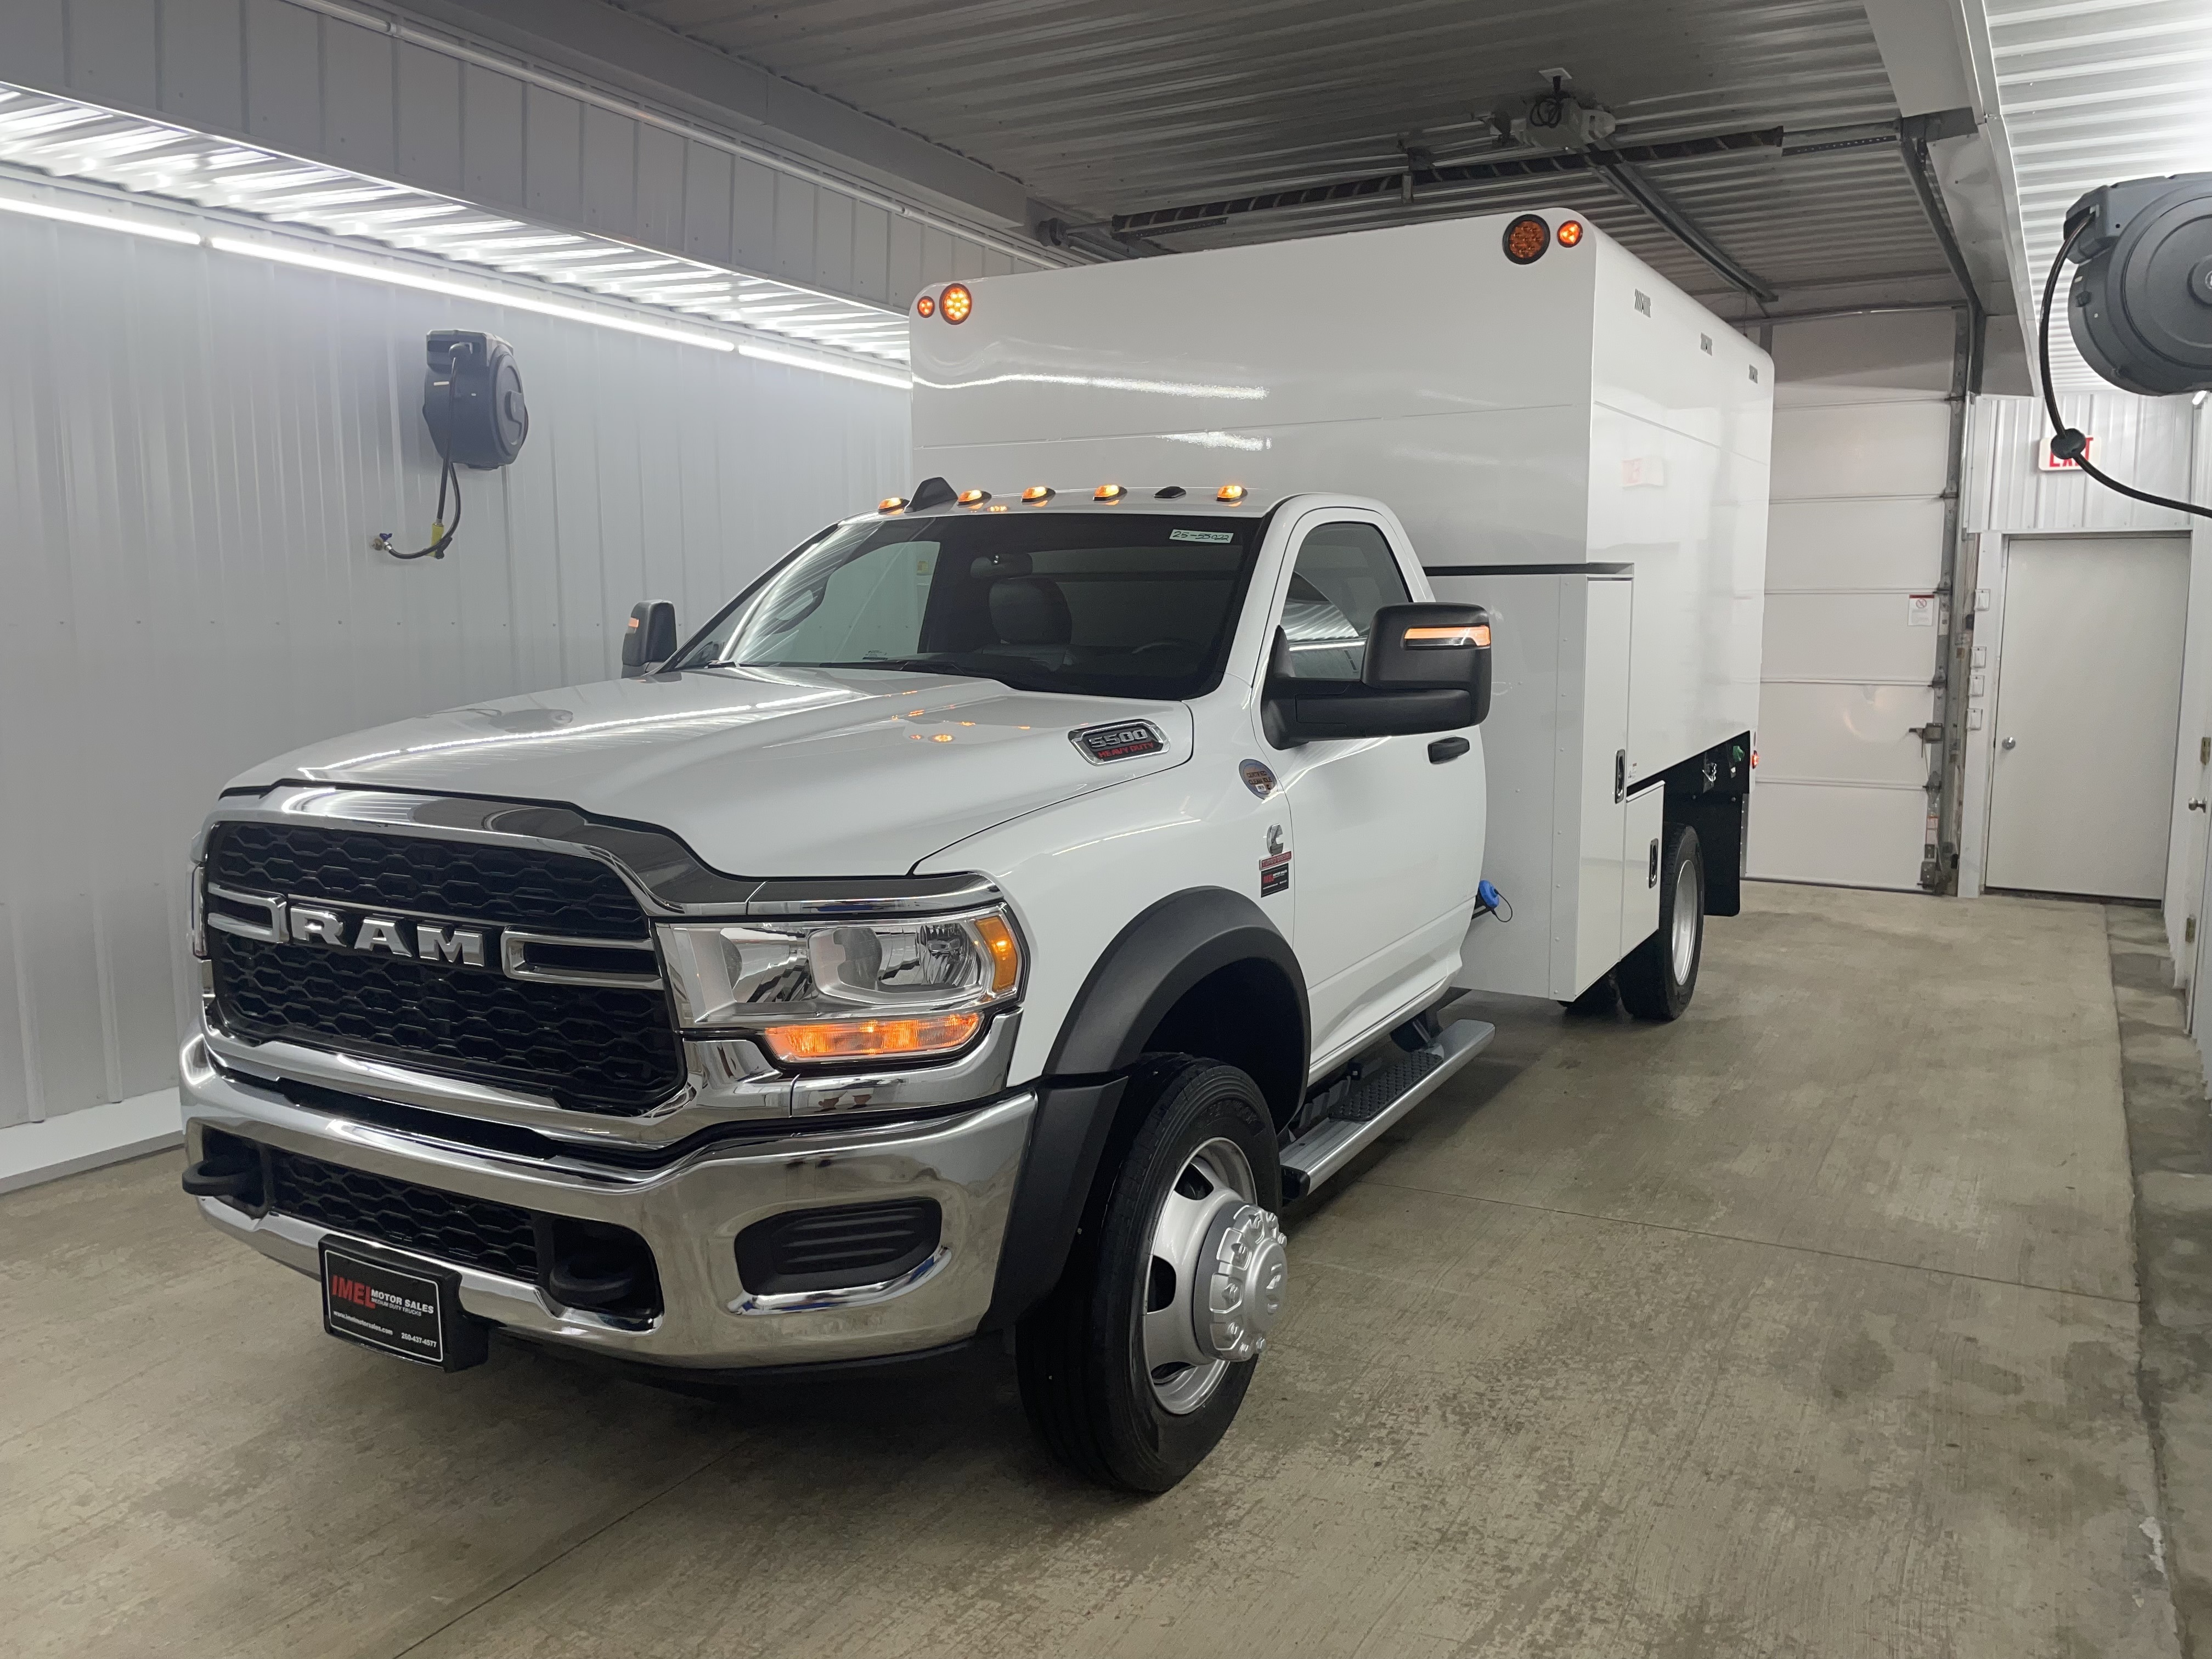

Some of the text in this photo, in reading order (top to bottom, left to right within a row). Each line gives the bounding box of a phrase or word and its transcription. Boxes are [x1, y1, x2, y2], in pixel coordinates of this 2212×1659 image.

[1088, 729, 1148, 749] 5500
[1098, 742, 1154, 758] HEAVY DUTY
[290, 906, 485, 967] RAM
[332, 1274, 376, 1310] IMEL
[371, 1289, 435, 1314] MOTOR SALES
[389, 1303, 402, 1312] DUTY
[402, 1307, 422, 1317] TRUCKS
